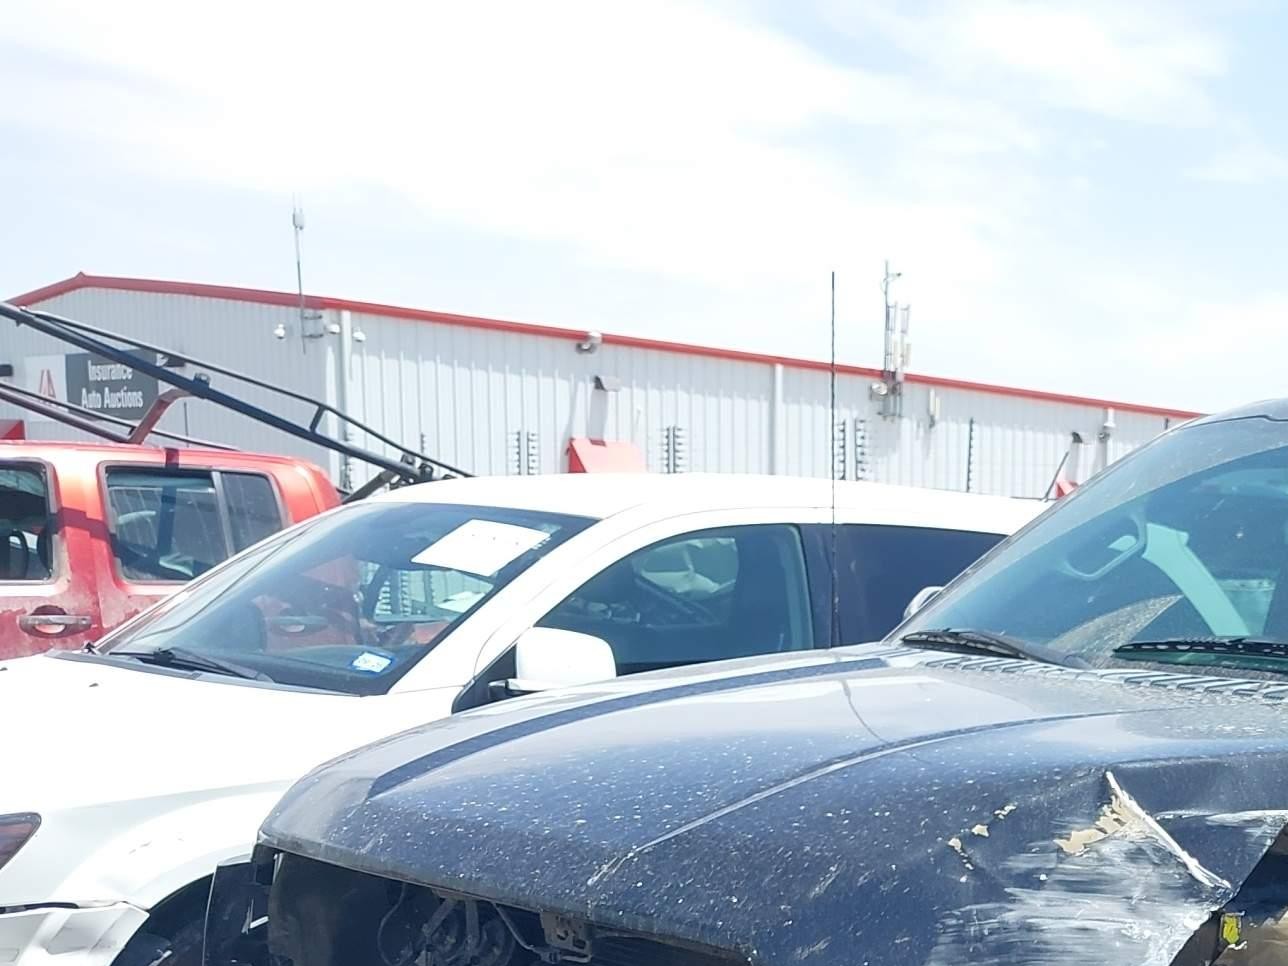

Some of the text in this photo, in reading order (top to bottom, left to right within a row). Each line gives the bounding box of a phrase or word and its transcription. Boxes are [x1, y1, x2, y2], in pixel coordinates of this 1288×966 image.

[87, 360, 133, 381] Insurance
[81, 386, 144, 408] Auto Auctions
